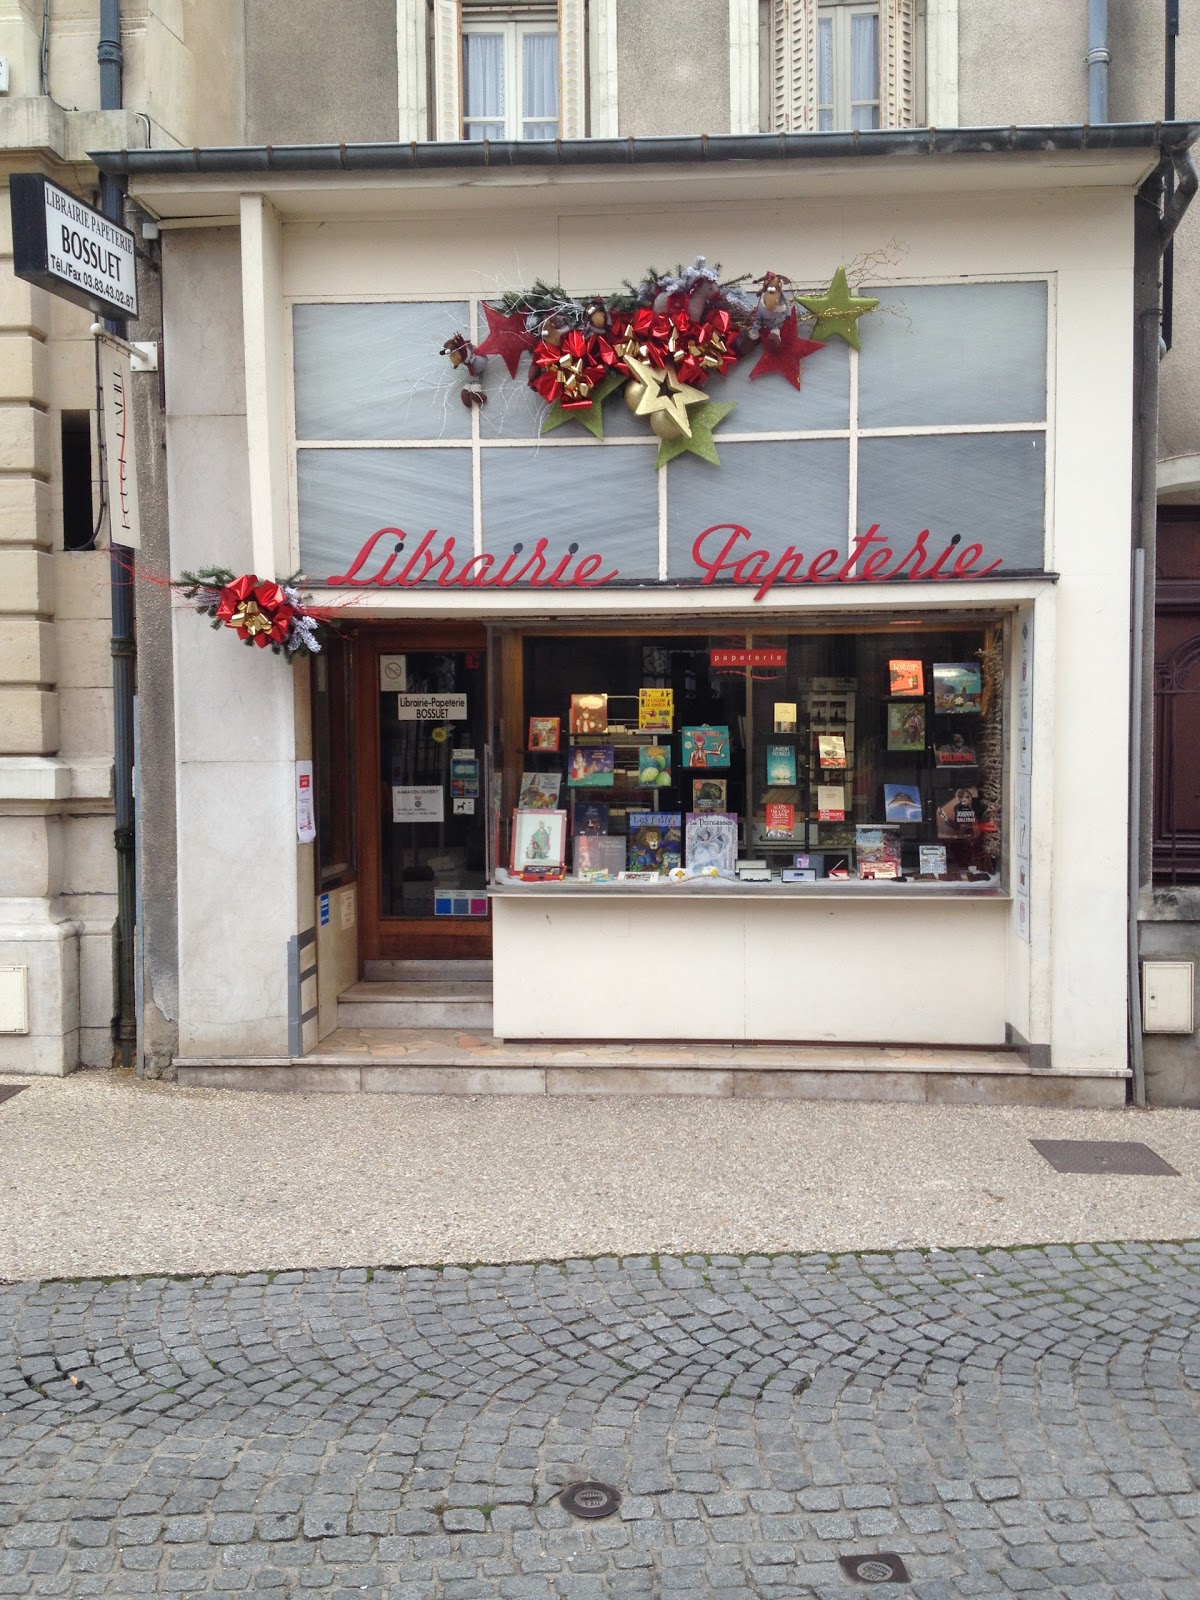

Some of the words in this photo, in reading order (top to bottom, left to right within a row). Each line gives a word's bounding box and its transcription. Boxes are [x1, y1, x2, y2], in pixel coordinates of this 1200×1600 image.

[45, 186, 90, 229] LIBRAIRIE
[91, 215, 133, 255] PAPETERIE
[61, 224, 121, 282] BOSSUET
[325, 527, 619, 587] Librairie
[692, 523, 1003, 601] Papeterie
[714, 653, 782, 662] papeterie
[400, 696, 465, 708] Librairie-Papeterie
[416, 708, 449, 719] BOSSUET
